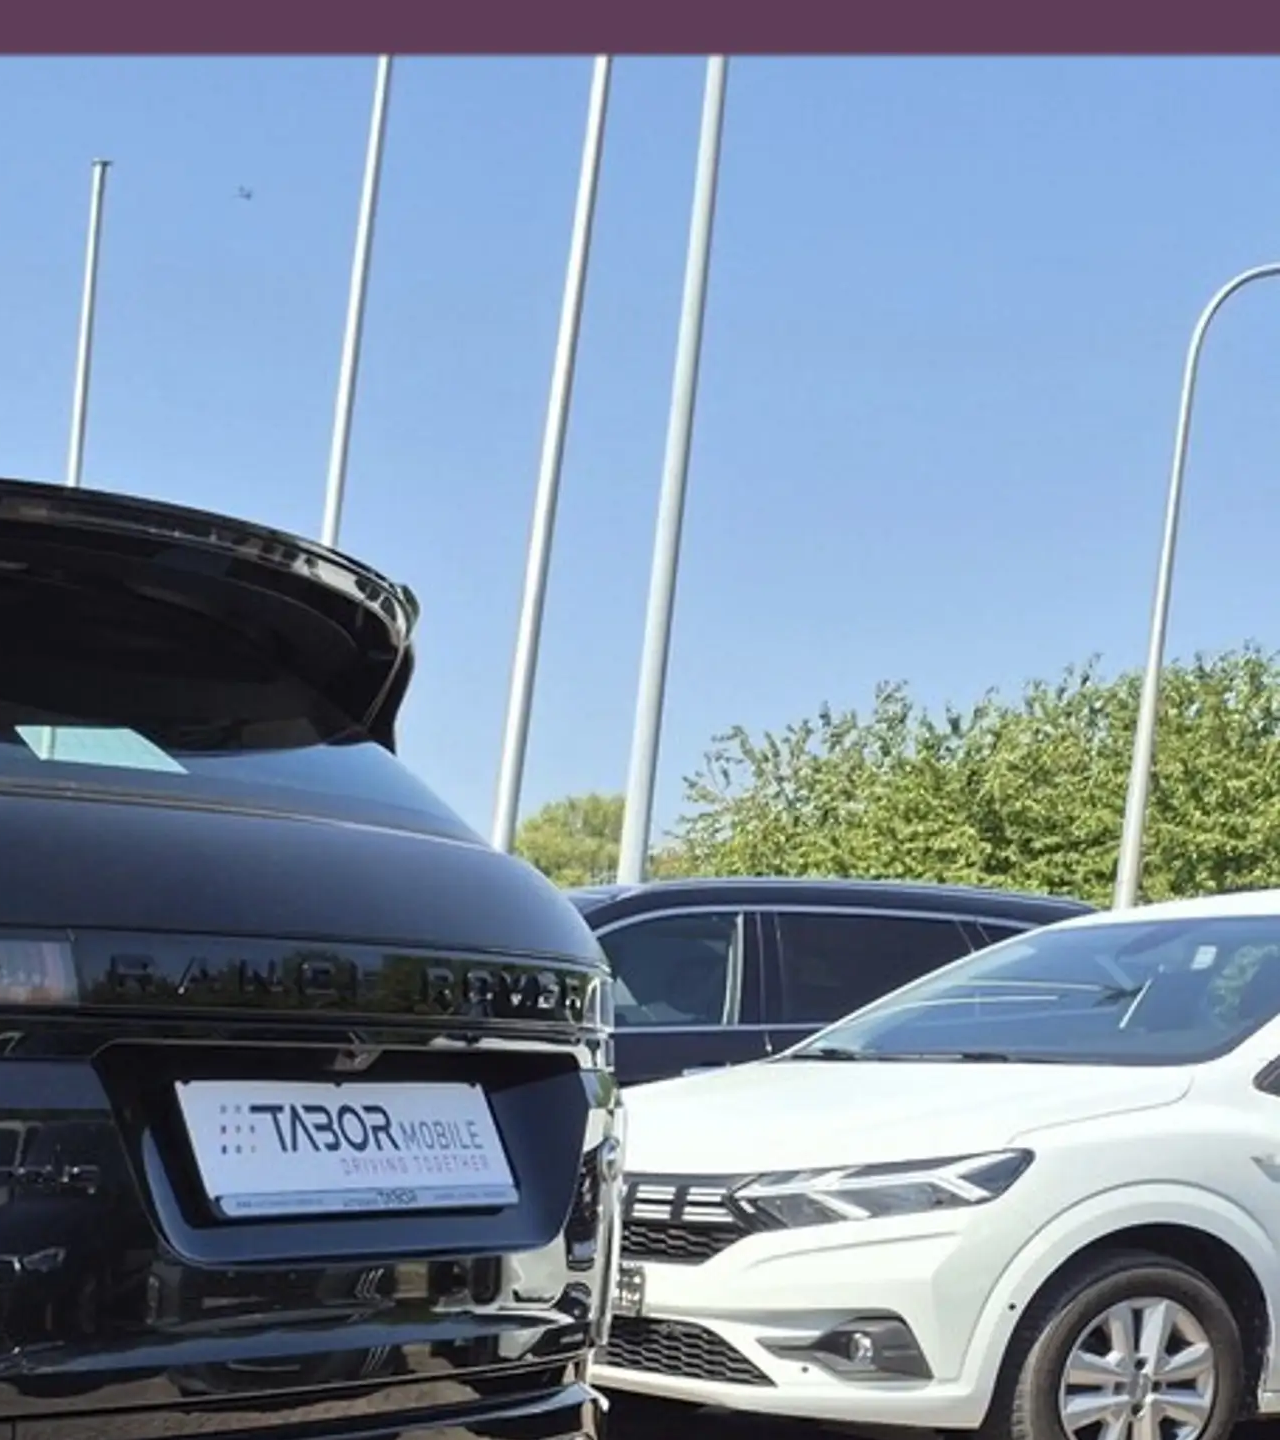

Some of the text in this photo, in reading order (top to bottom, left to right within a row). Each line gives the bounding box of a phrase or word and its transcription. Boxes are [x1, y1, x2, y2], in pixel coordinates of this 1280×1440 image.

[248, 1103, 485, 1153] TABOR MOBILE
[340, 1154, 490, 1176] DRIVING TOGETHER
